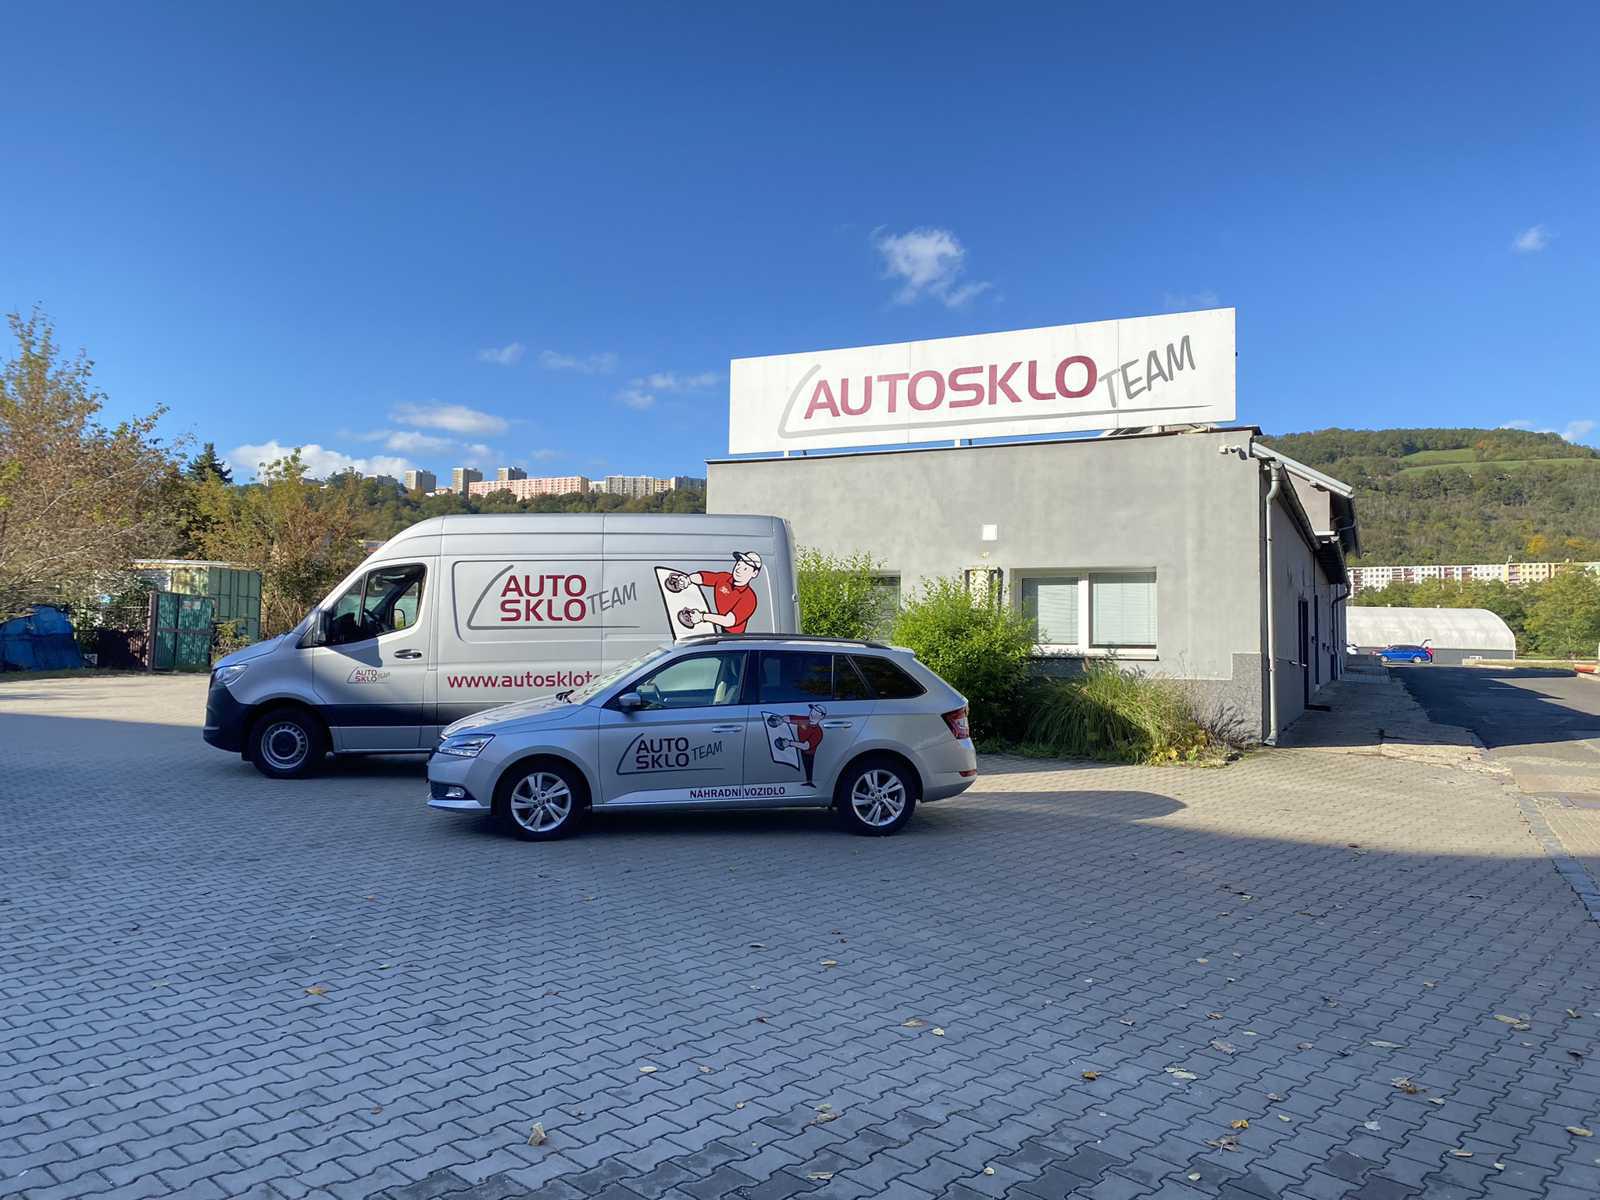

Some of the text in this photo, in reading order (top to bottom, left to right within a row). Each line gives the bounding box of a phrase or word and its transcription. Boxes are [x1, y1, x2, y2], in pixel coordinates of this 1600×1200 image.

[804, 335, 1196, 419] AUTOSKLO TEAM
[501, 574, 587, 598] AUTO
[587, 582, 637, 615] TEAM
[500, 598, 587, 622] SKLO
[636, 736, 689, 755] AUTO
[691, 740, 723, 761] TEAM
[635, 752, 690, 770] SKLO
[744, 786, 785, 796] VOZIDLO
